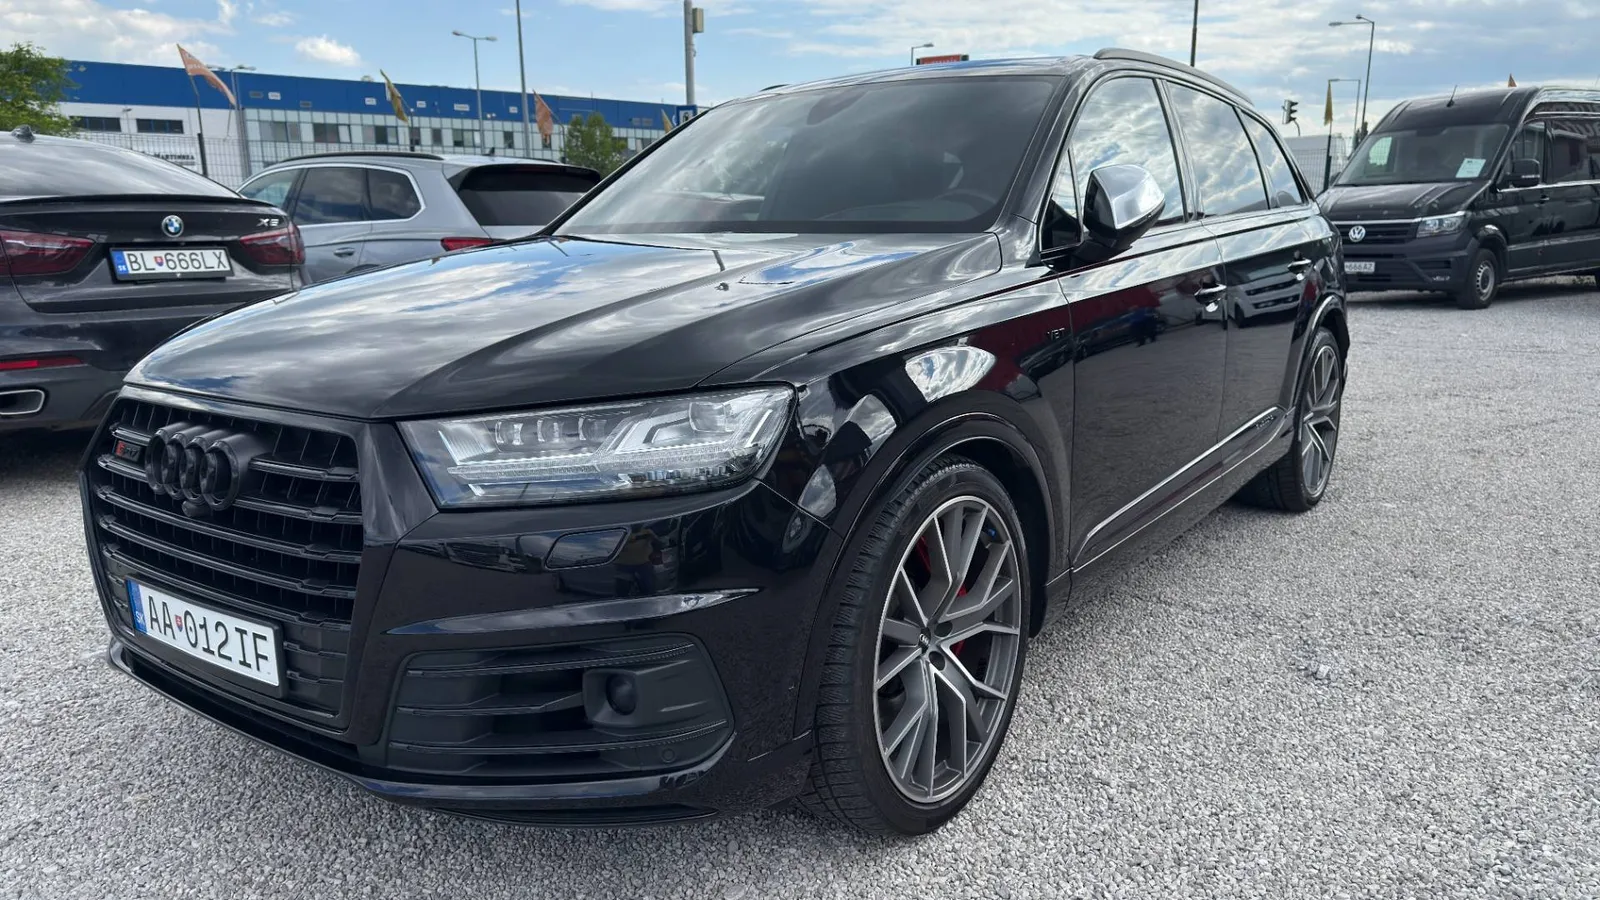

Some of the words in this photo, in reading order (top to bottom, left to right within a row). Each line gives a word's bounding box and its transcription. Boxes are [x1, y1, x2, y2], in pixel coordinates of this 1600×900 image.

[127, 252, 156, 272] BL
[165, 251, 228, 270] 666LX
[135, 610, 145, 623] SK
[148, 595, 176, 640] AA
[183, 610, 269, 672] 012IF
